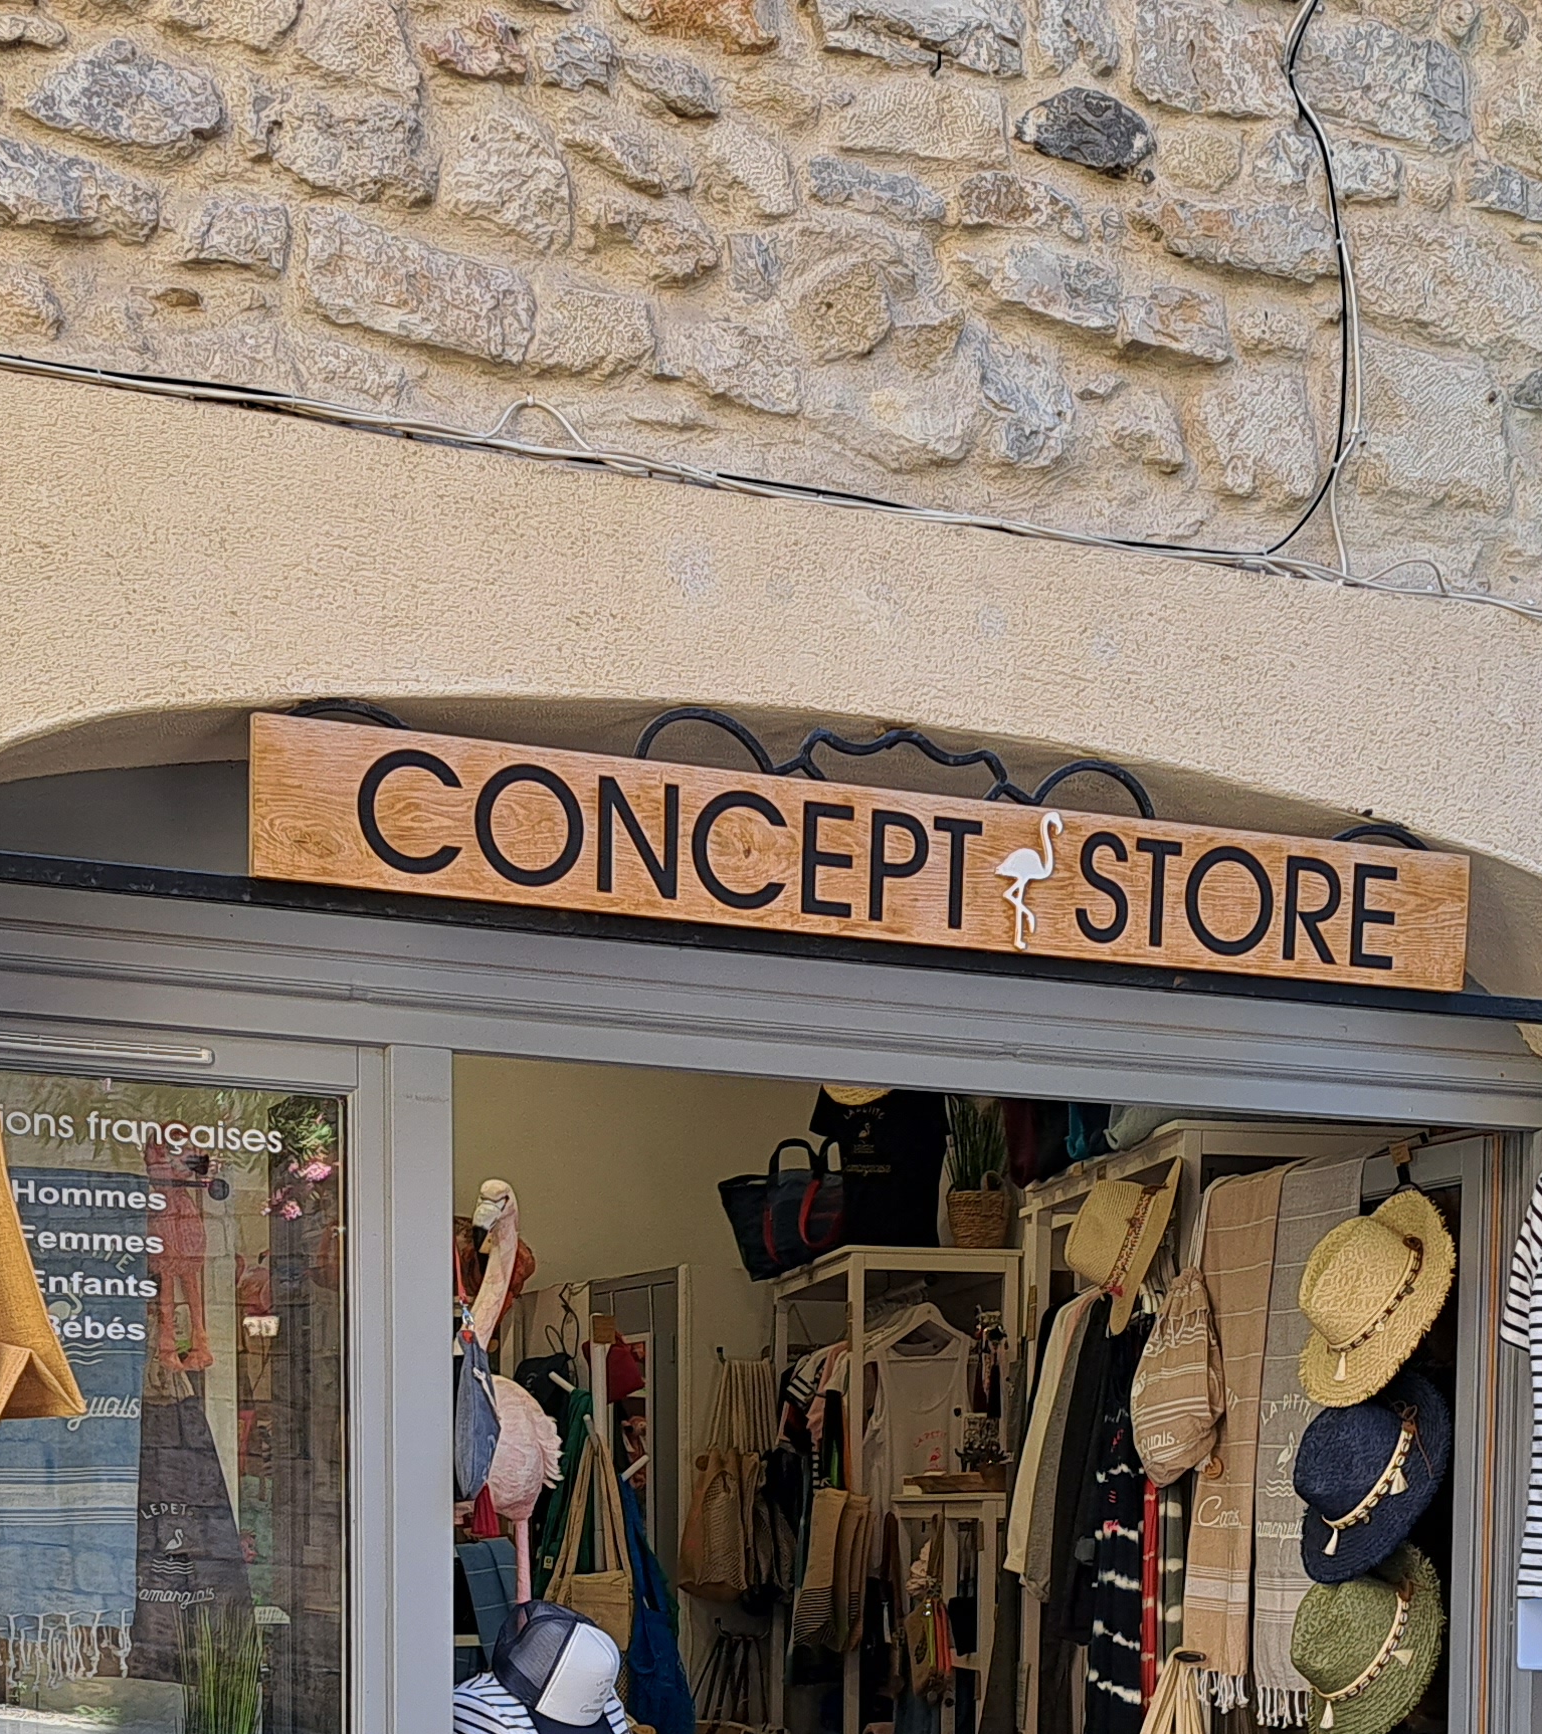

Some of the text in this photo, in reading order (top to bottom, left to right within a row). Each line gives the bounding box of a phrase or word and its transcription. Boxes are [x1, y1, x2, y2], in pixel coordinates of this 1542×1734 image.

[357, 748, 1396, 970] CONCEPT STORE
[86, 1111, 283, 1154] françaises
[13, 1179, 167, 1211] Hommes
[22, 1224, 165, 1255] Femmes
[32, 1270, 159, 1299] Enfants
